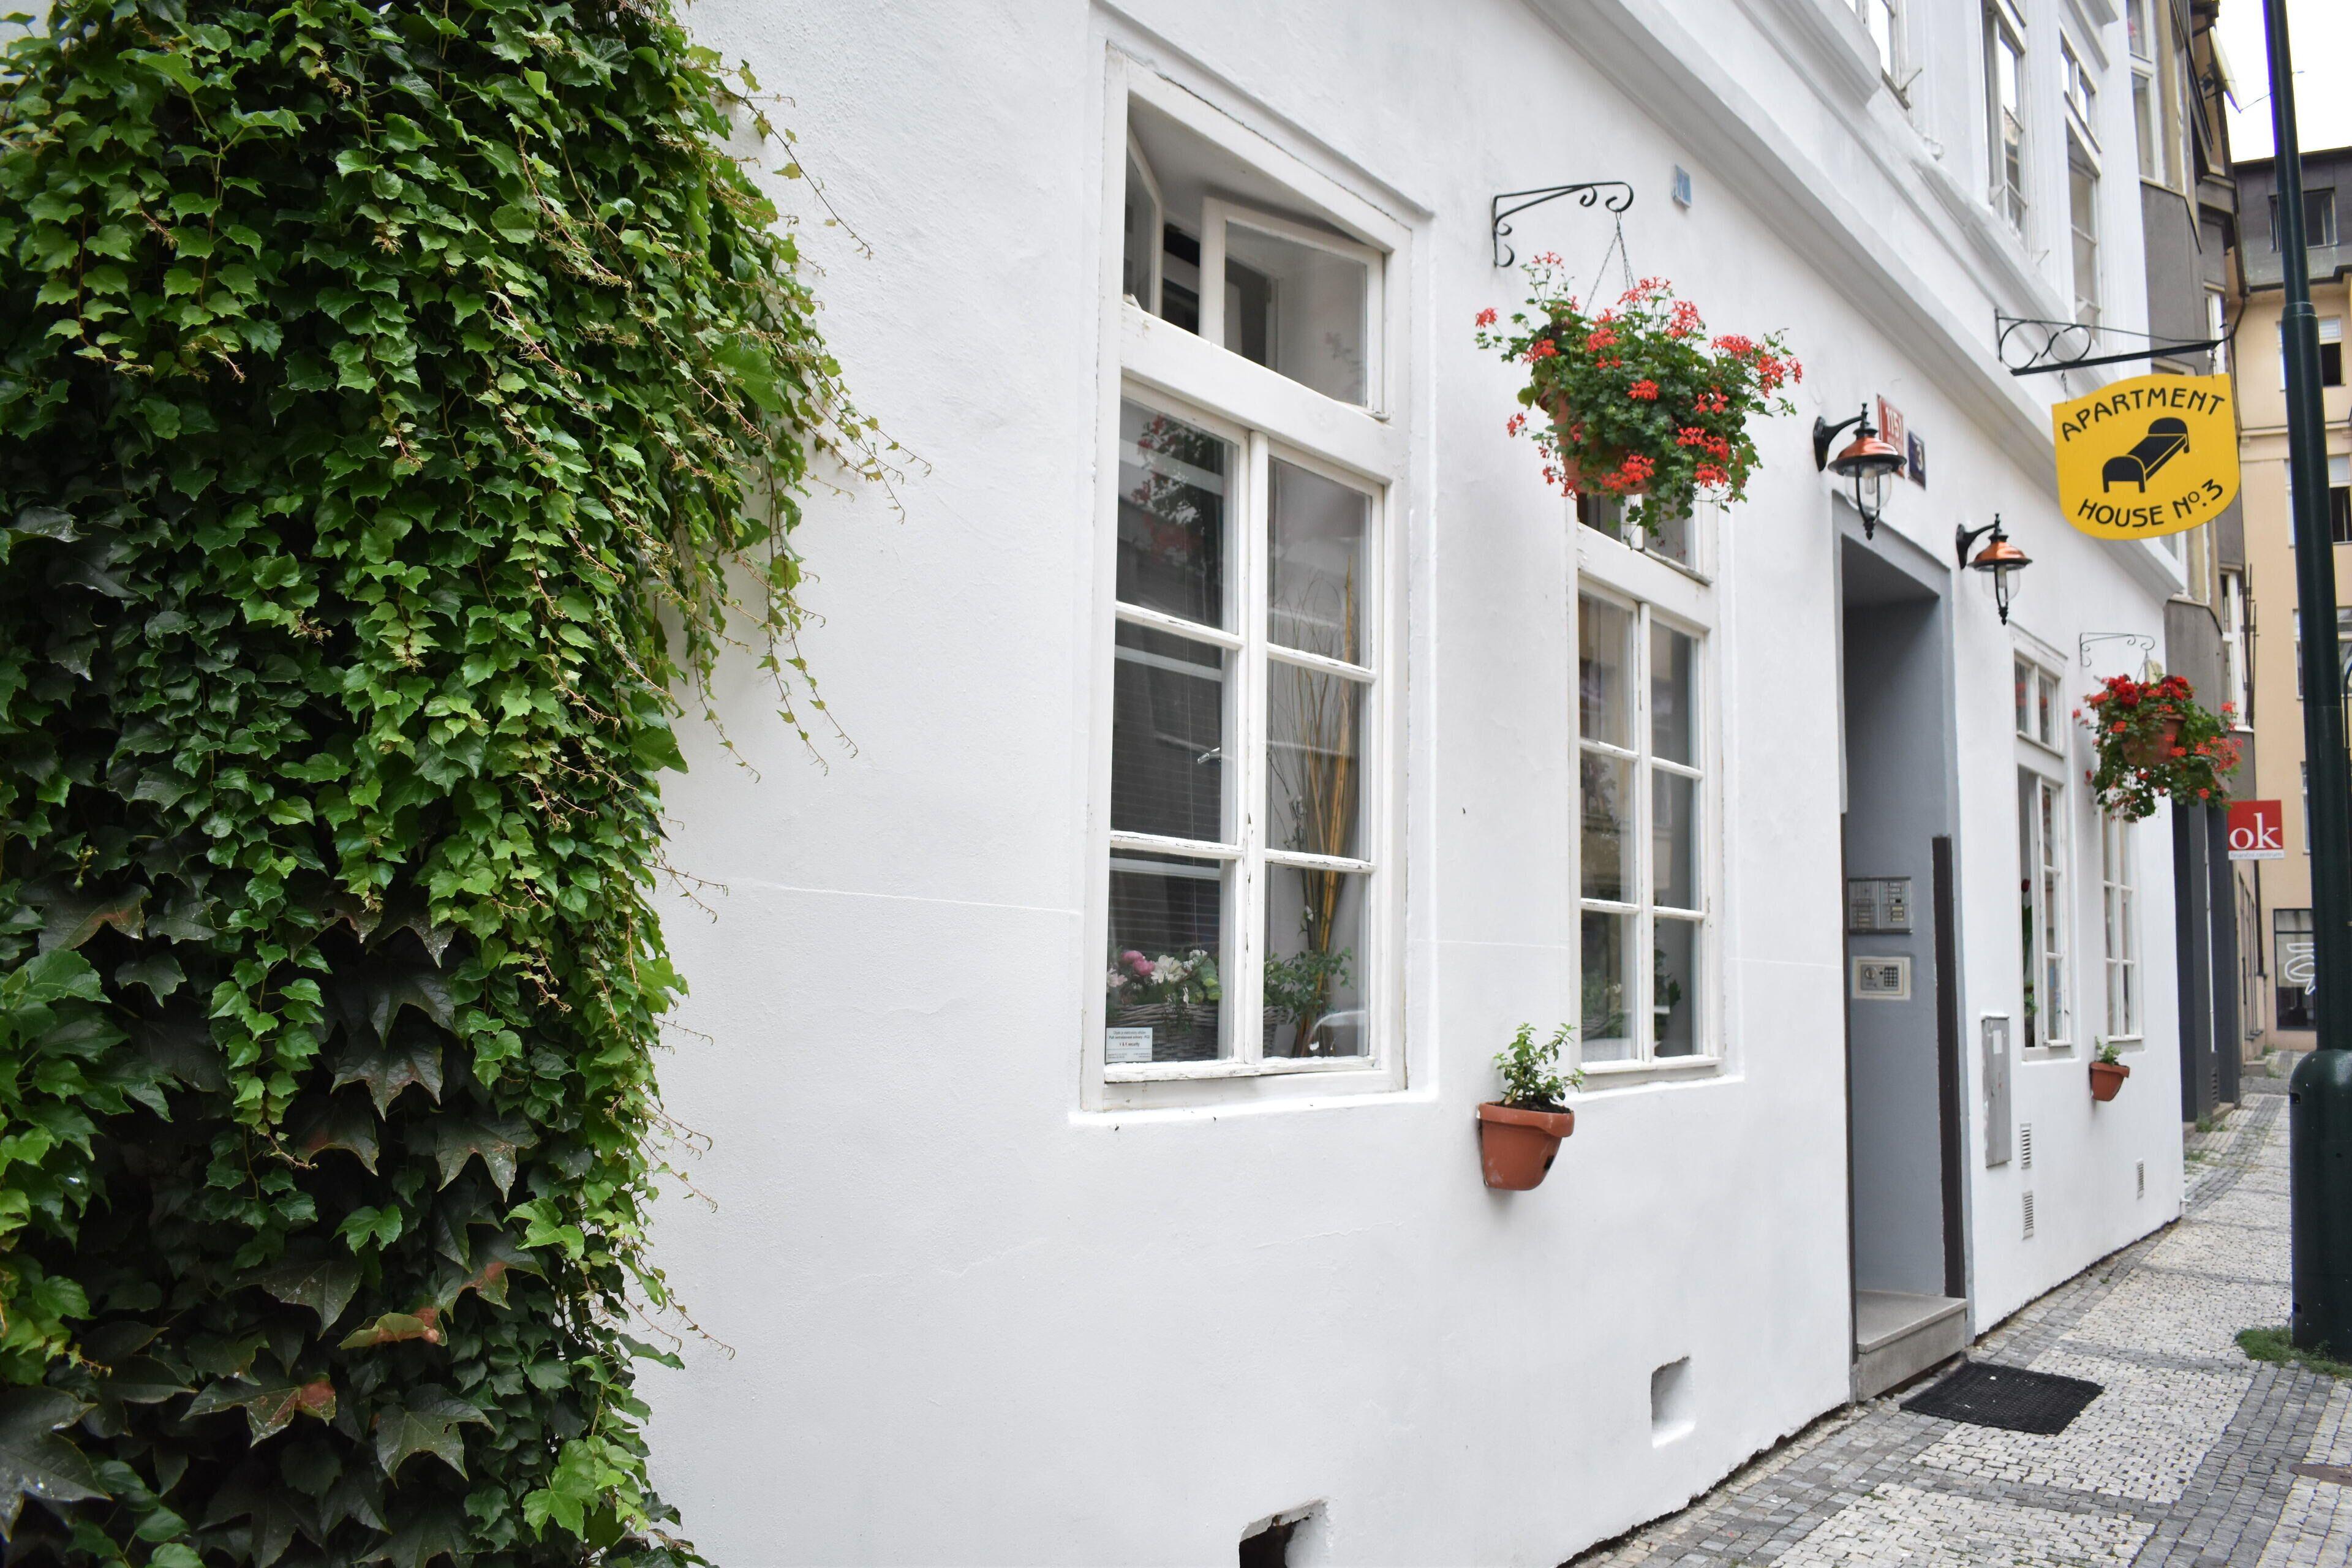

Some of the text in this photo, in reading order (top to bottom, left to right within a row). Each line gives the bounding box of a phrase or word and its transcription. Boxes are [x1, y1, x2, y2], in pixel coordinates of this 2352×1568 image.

[2062, 387, 2225, 442] APARTMENT
[2077, 498, 2165, 528] HOUSE
[2229, 812, 2282, 850] ok
